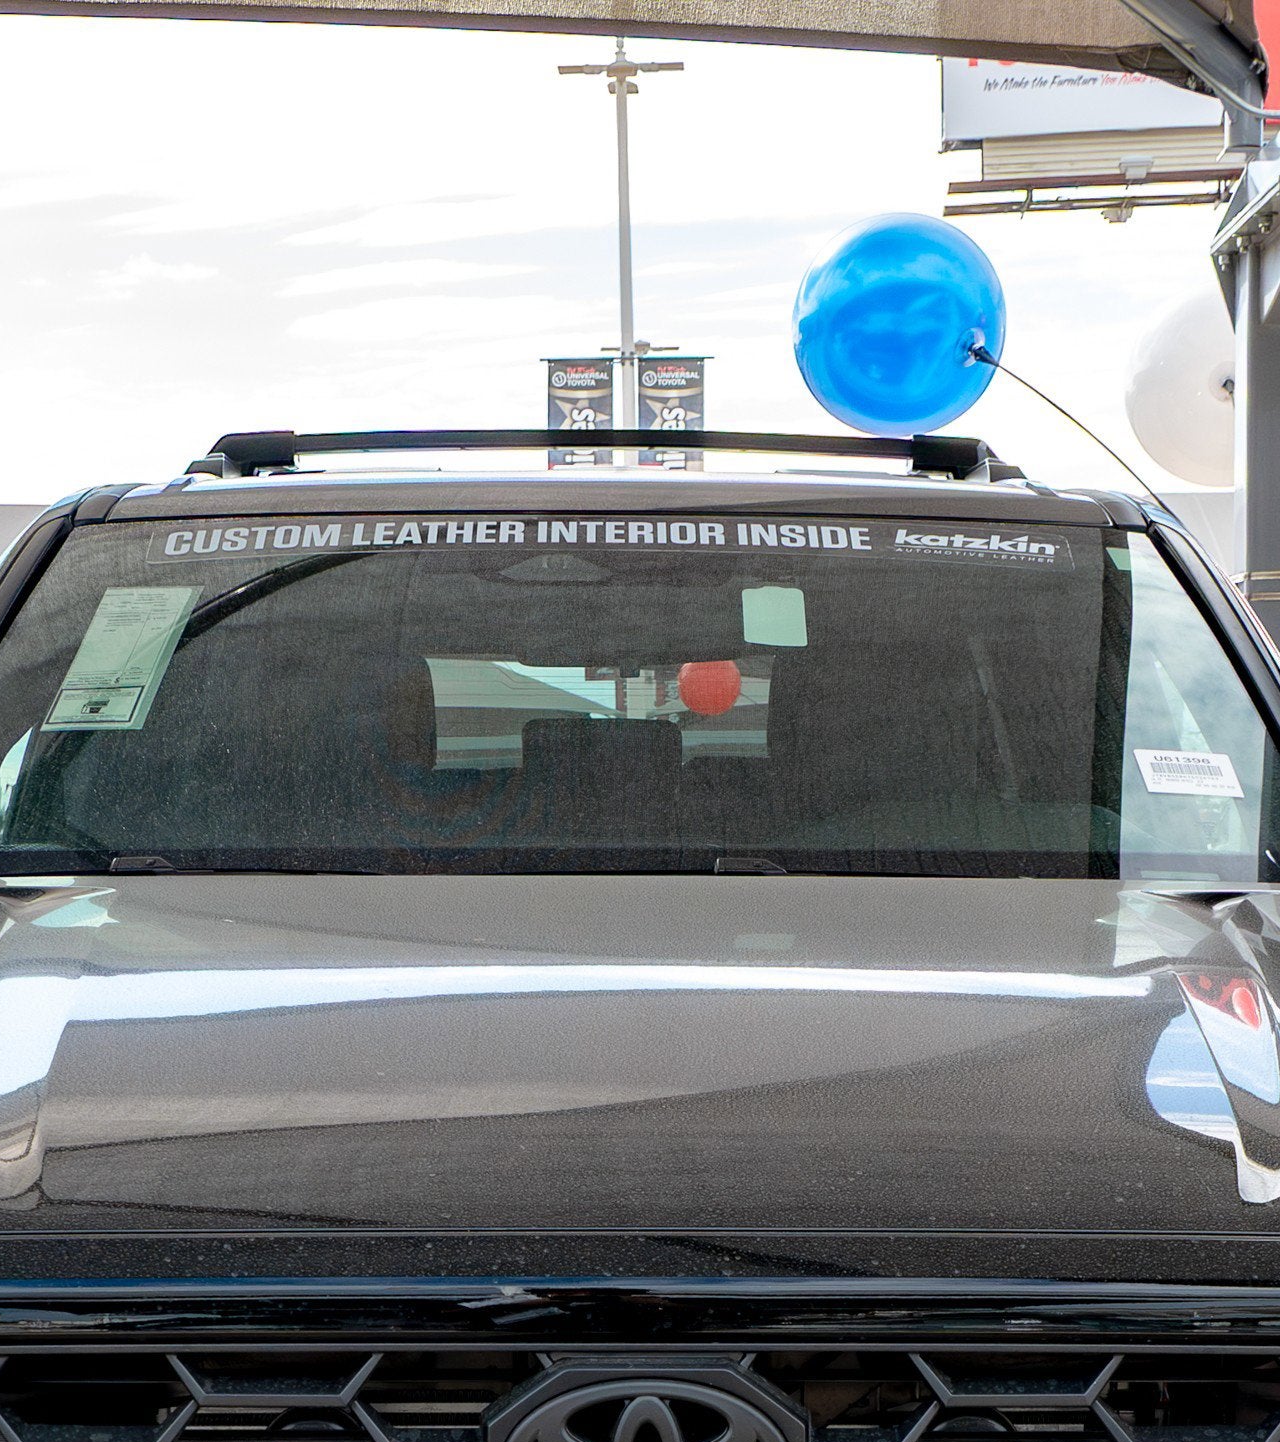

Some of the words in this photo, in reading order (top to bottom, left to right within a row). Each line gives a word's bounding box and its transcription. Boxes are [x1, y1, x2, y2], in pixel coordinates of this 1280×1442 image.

[983, 78, 999, 92] We
[1000, 76, 1029, 91] Make
[1031, 75, 1048, 89] the
[1049, 75, 1098, 89] Furniture
[567, 372, 609, 380] UNIVERSAL
[658, 372, 700, 380] UNIVERSAL
[567, 379, 596, 387] TOYOTA
[658, 379, 687, 387] TOYOTA
[164, 523, 342, 556] CUSTOM
[351, 520, 526, 547] LEATHER
[537, 520, 726, 547] INTERIOR
[736, 522, 873, 551] INSIDE
[894, 528, 1056, 556] katzkin
[895, 547, 985, 558] AUTOMOTIVE
[993, 554, 1055, 564] LEATHER
